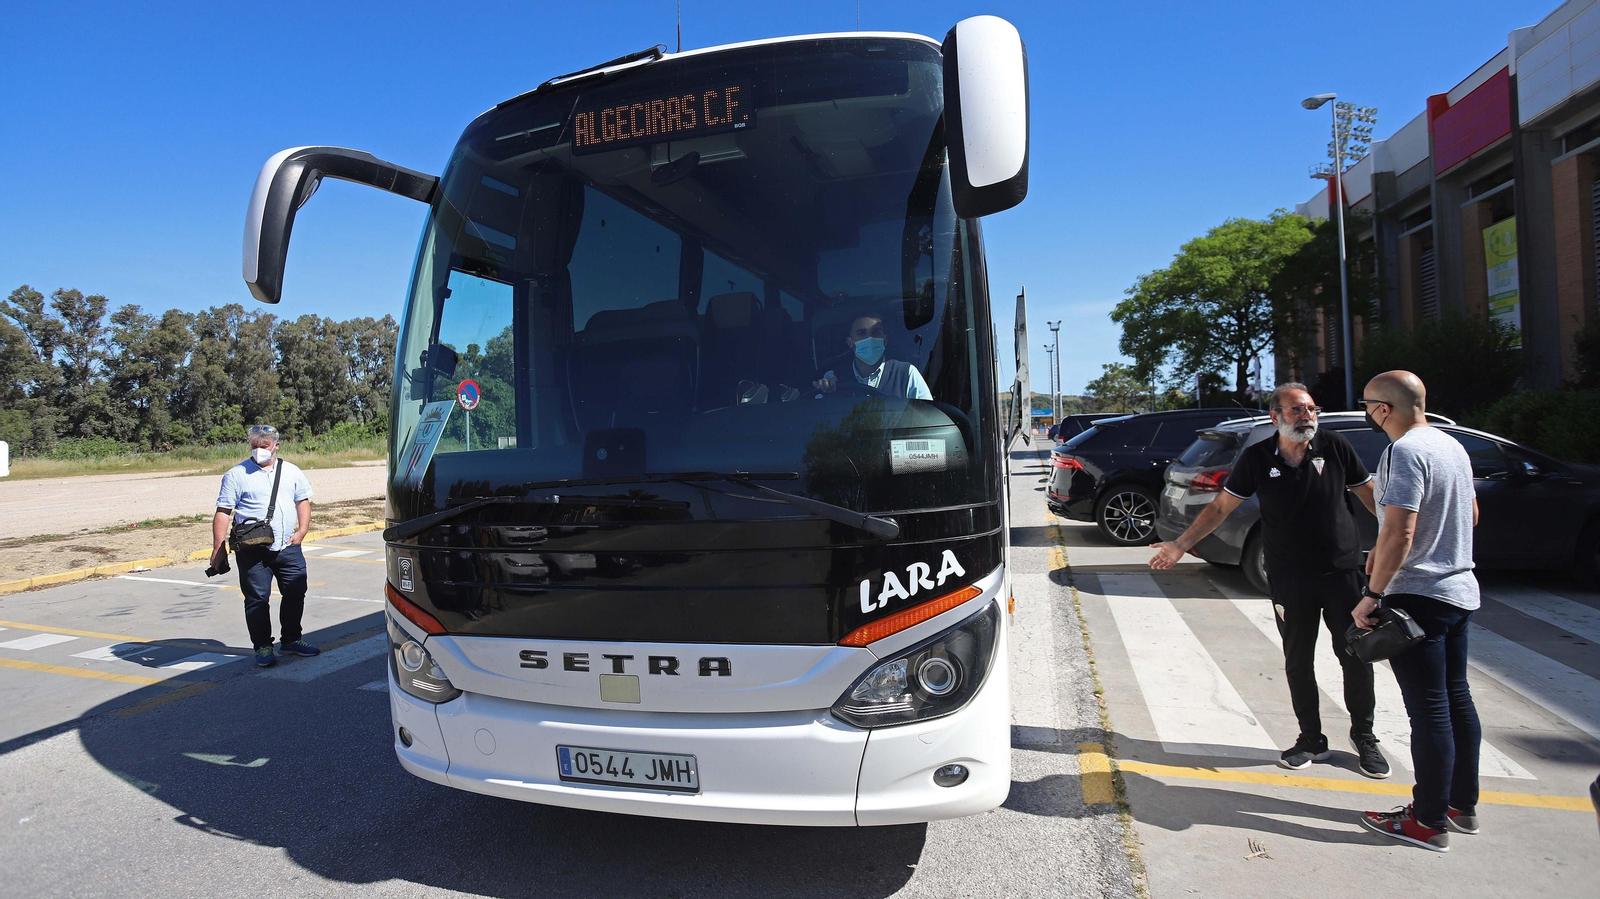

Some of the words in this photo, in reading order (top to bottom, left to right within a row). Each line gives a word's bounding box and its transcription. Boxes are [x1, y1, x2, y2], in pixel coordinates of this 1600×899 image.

[575, 94, 697, 147] ALGECIRAS
[703, 86, 749, 125] C.F.
[860, 549, 966, 614] LARA
[518, 649, 732, 677] SETRA
[575, 751, 635, 779] 0544
[644, 759, 692, 783] JMH
